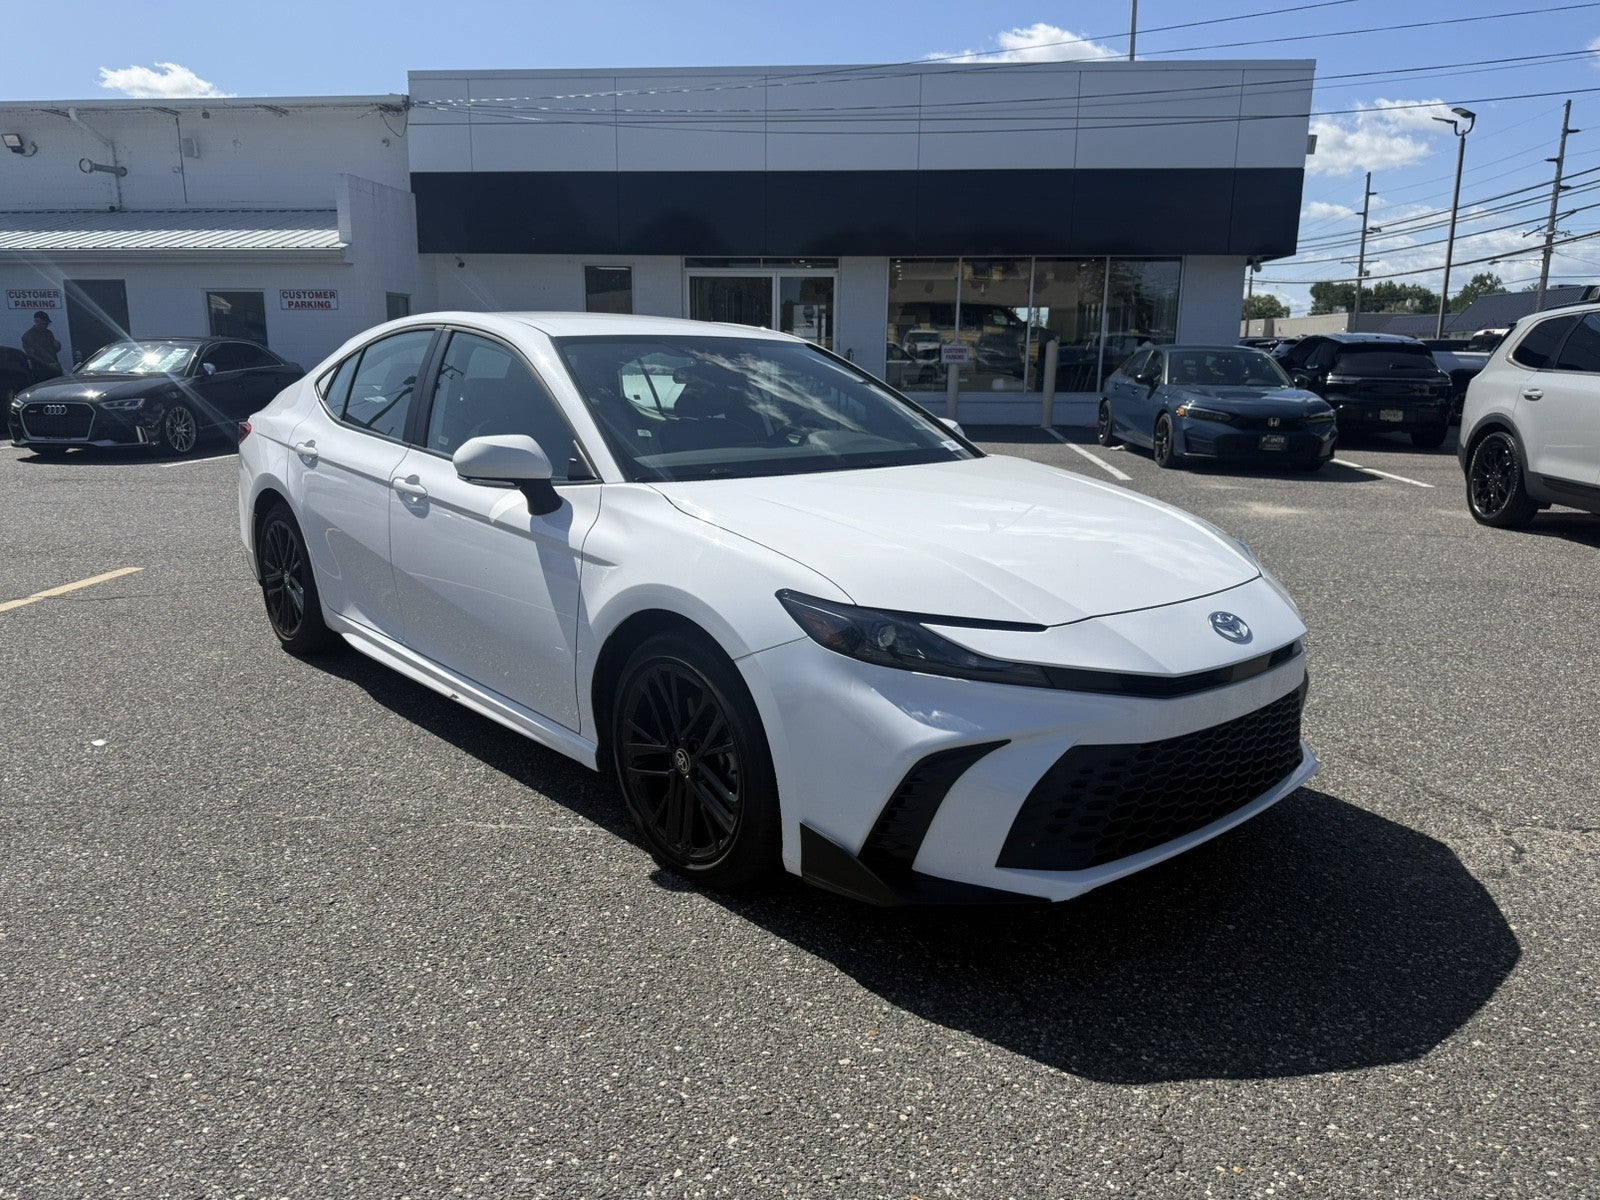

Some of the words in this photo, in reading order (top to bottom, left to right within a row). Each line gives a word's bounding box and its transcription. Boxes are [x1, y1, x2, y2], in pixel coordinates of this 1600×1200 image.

[8, 290, 59, 299] CUSTOMER
[281, 291, 336, 299] CUSTOMER
[14, 300, 56, 308] PARKING
[287, 300, 331, 309] PARKING
